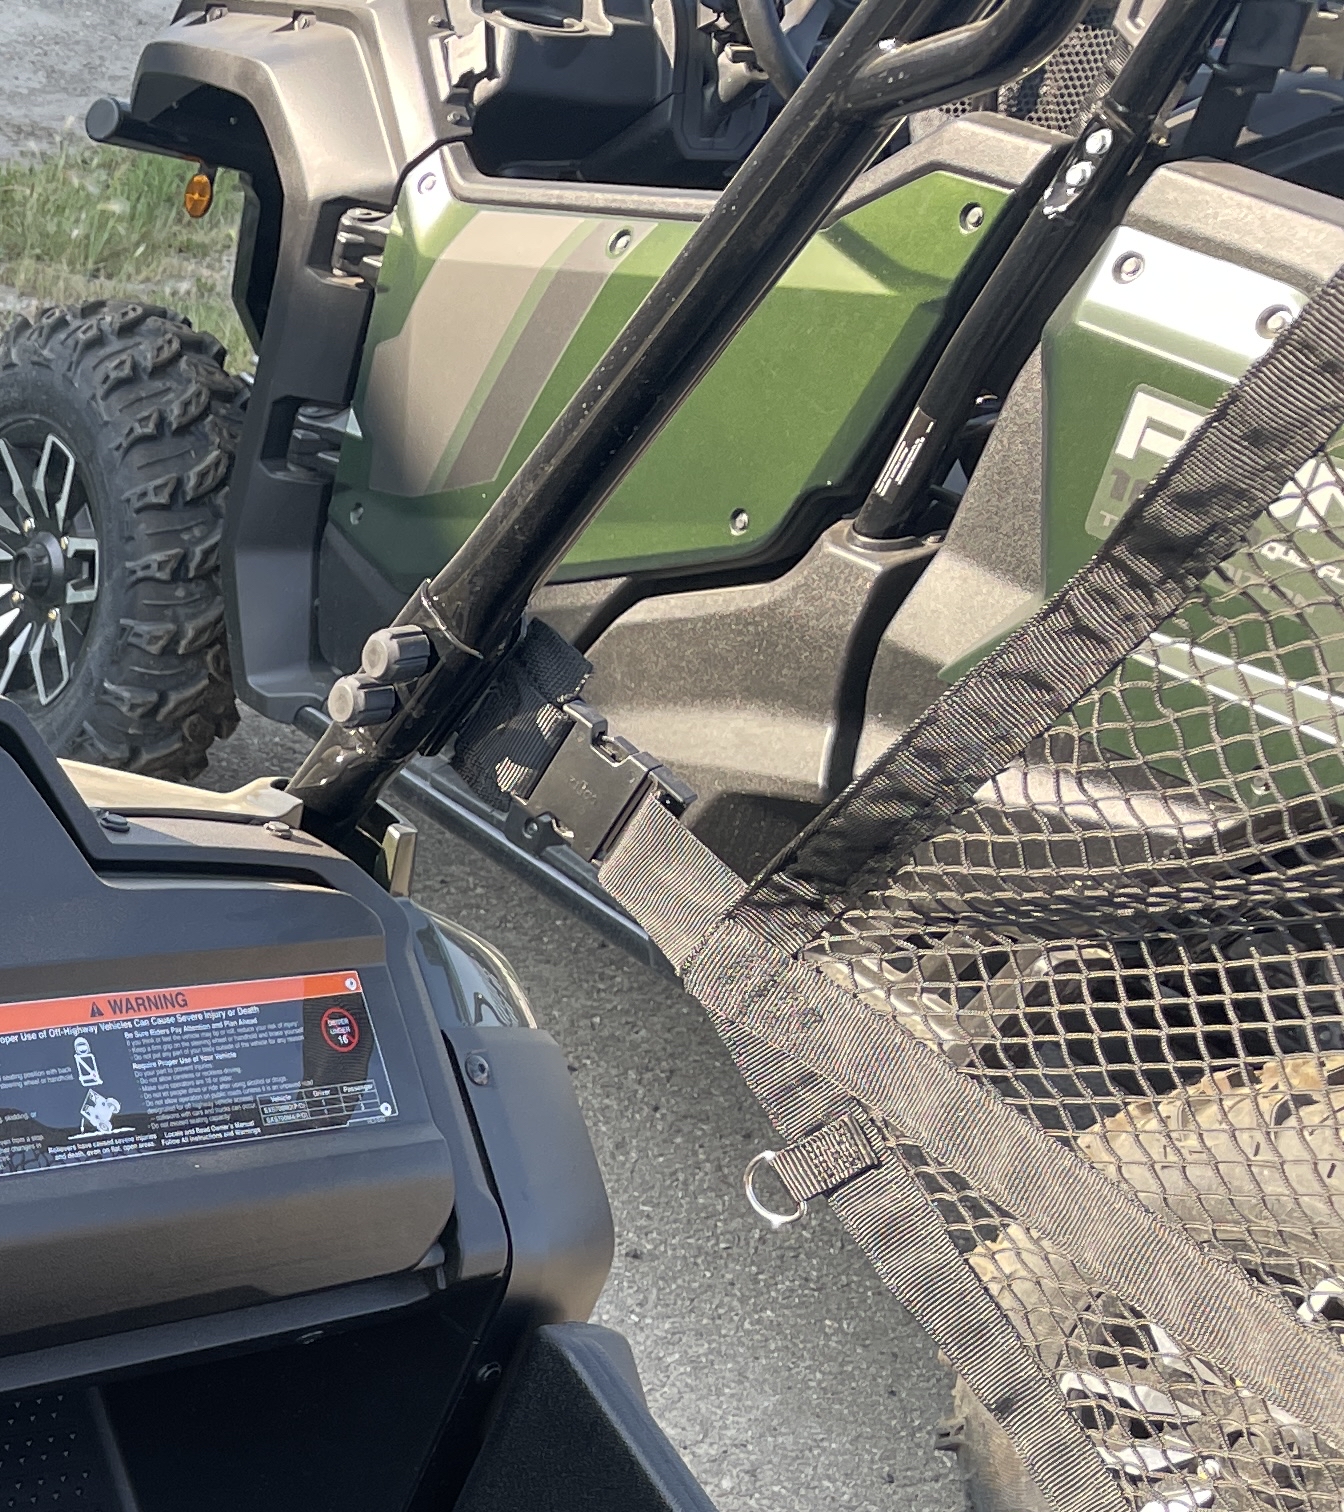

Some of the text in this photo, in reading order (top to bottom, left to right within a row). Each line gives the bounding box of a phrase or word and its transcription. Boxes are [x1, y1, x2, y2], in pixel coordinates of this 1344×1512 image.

[108, 991, 188, 1016] WARNING
[20, 1031, 37, 1041] Use
[37, 1030, 46, 1038] of
[48, 1024, 98, 1039] Off-Highway
[99, 1020, 132, 1031] Vehicles
[133, 1018, 149, 1027] Can
[150, 1015, 175, 1025] Cause
[176, 1012, 202, 1022] Severe
[203, 1010, 226, 1021] Injury
[237, 1005, 259, 1015] Death
[338, 1034, 349, 1044] 16
[312, 1088, 330, 1096] Driver
[342, 1082, 373, 1094] Passenger
